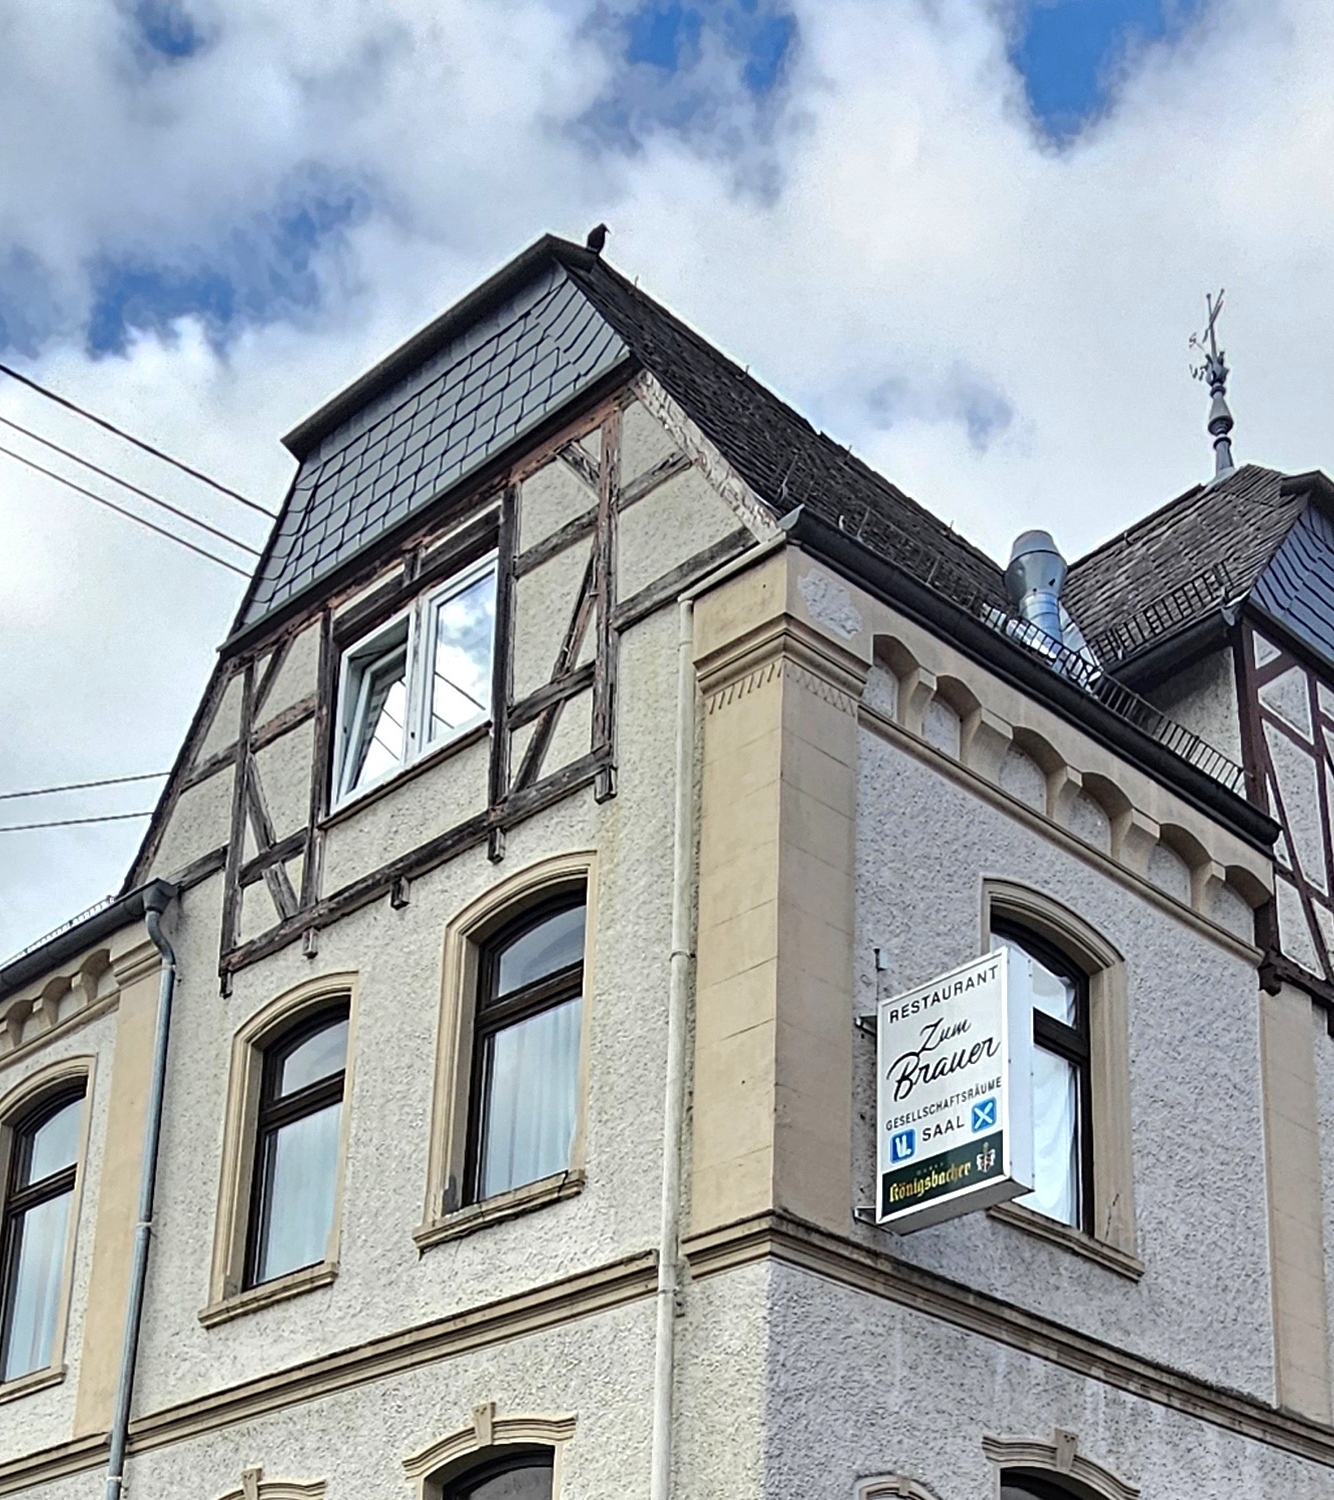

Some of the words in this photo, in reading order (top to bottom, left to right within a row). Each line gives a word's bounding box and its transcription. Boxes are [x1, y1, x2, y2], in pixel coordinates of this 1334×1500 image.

[889, 965, 999, 1024] RESTAURANT
[919, 1017, 972, 1054] Zum
[886, 1037, 1001, 1102] Brauer
[885, 1076, 1002, 1131] GESELLSCHAFTSRÄUME
[922, 1116, 965, 1142] SAAL
[889, 1161, 971, 1203] Königsbacher
